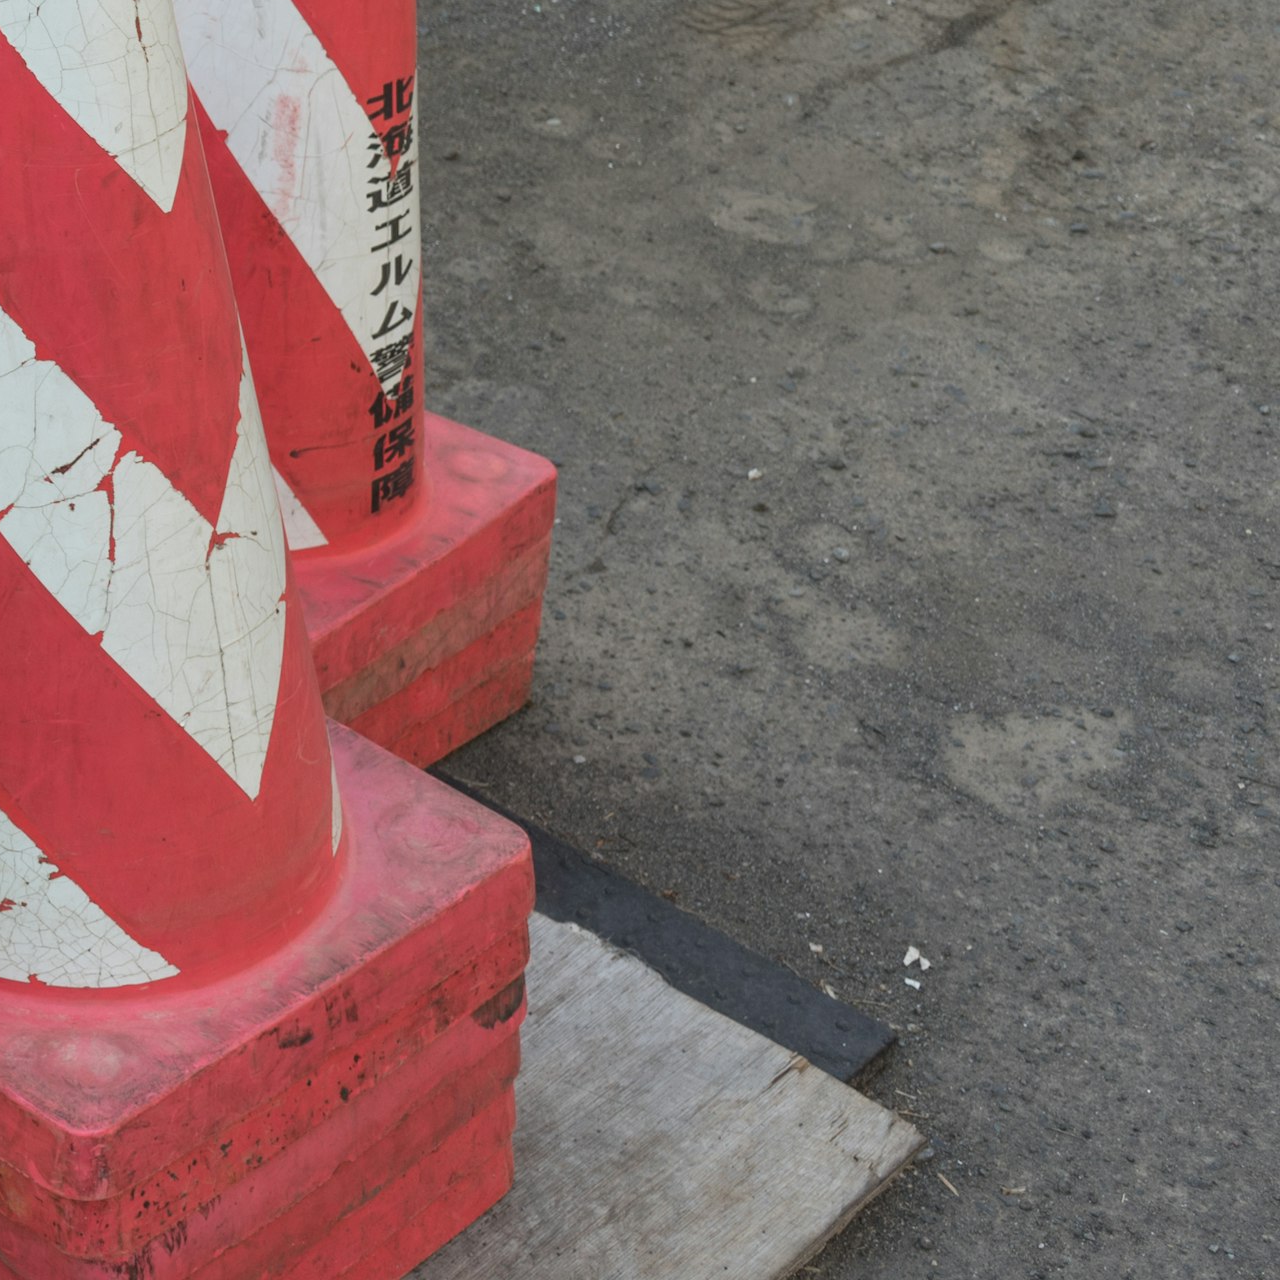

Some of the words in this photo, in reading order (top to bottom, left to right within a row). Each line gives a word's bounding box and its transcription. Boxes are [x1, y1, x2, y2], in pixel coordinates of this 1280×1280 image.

[367, 76, 415, 513] 北海道エルム警備保障
